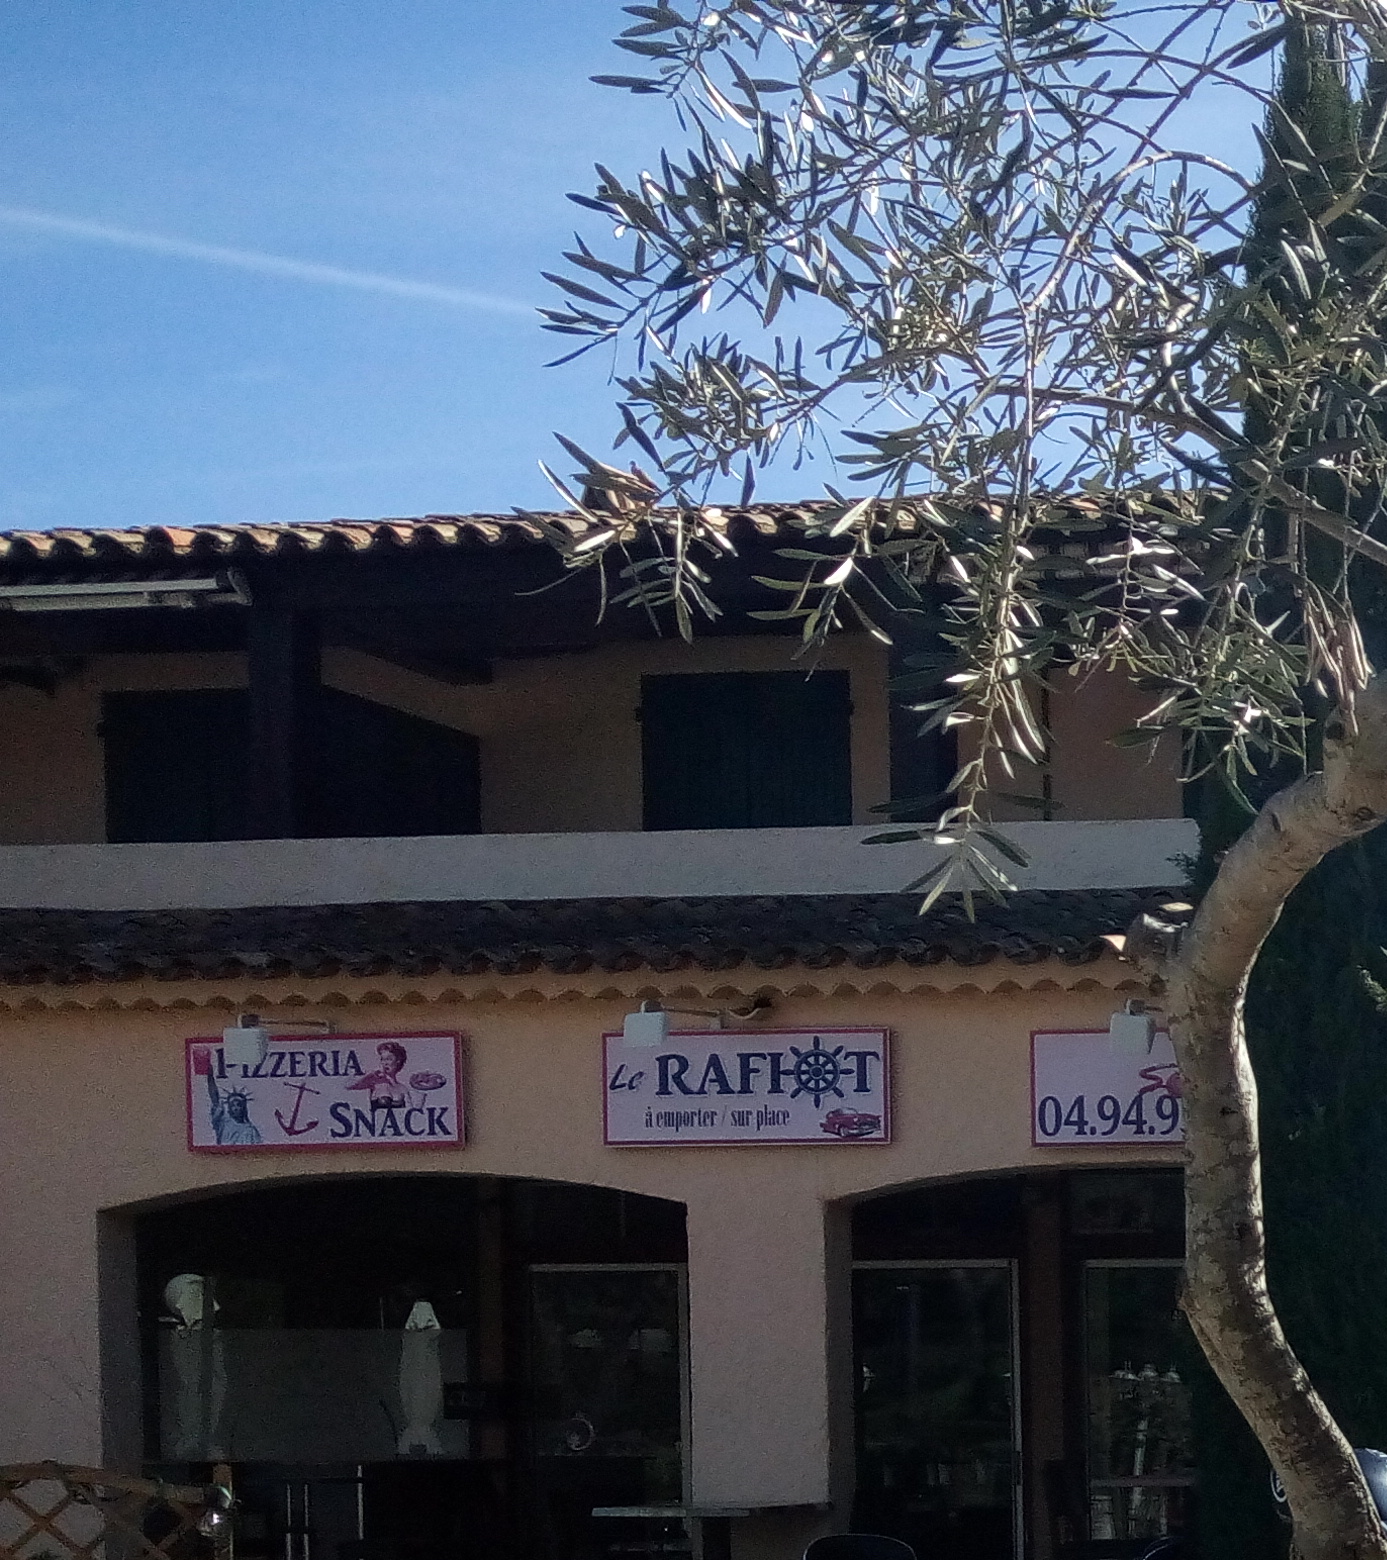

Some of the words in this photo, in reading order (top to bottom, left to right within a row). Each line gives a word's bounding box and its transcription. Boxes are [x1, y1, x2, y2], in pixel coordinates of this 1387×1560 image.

[609, 1064, 644, 1091] Le
[655, 1042, 881, 1102] RAFIOT
[329, 1101, 454, 1139] SNACK
[656, 1108, 718, 1132] emporter
[756, 1105, 791, 1131] place
